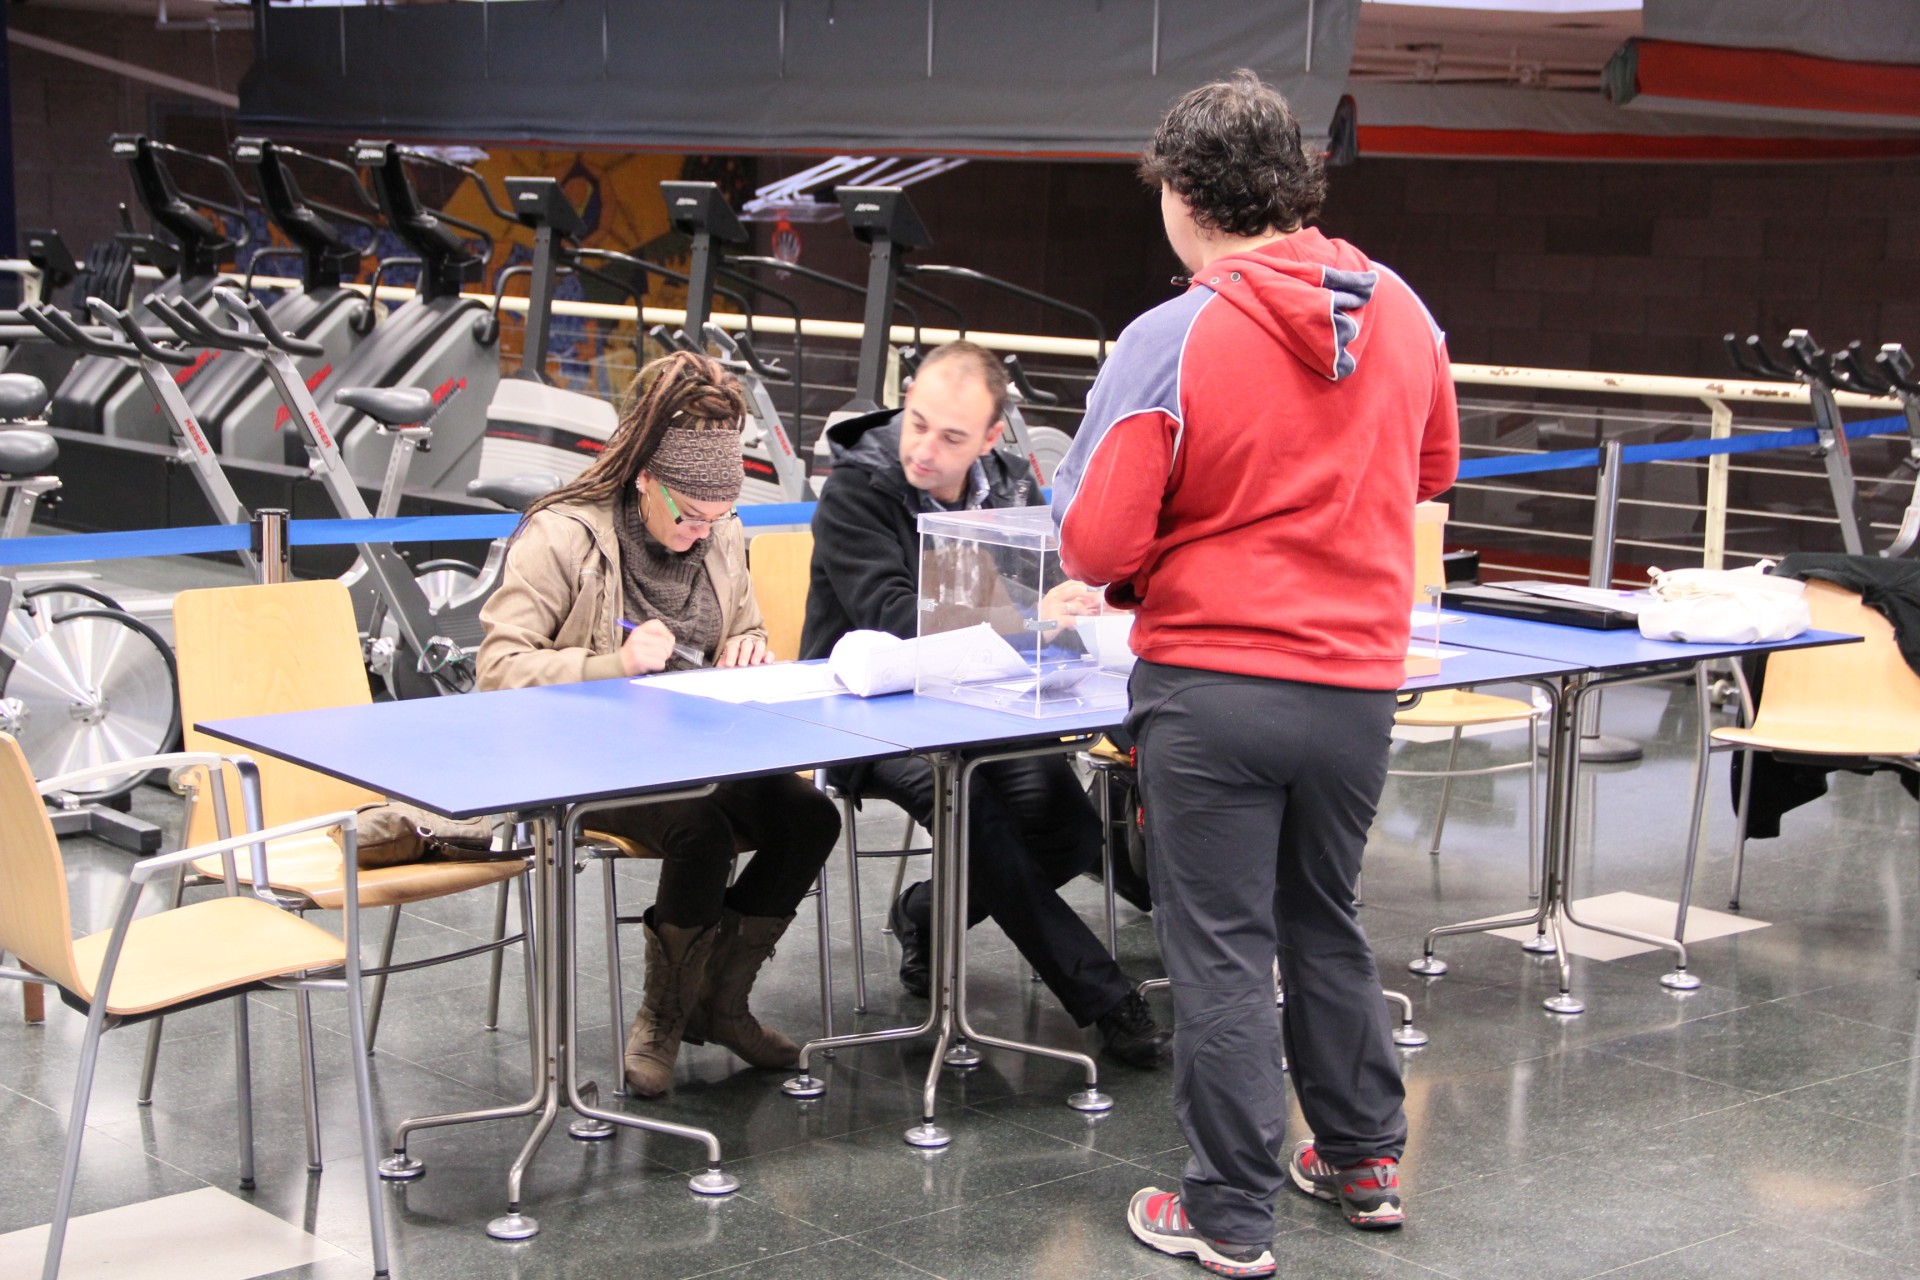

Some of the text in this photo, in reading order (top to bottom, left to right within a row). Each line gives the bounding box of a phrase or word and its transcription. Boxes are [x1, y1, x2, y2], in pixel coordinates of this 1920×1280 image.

[184, 418, 209, 456] KEISER
[308, 410, 332, 449] KEISER
[774, 424, 792, 457] KEISER
[1028, 451, 1045, 486] KEISER
